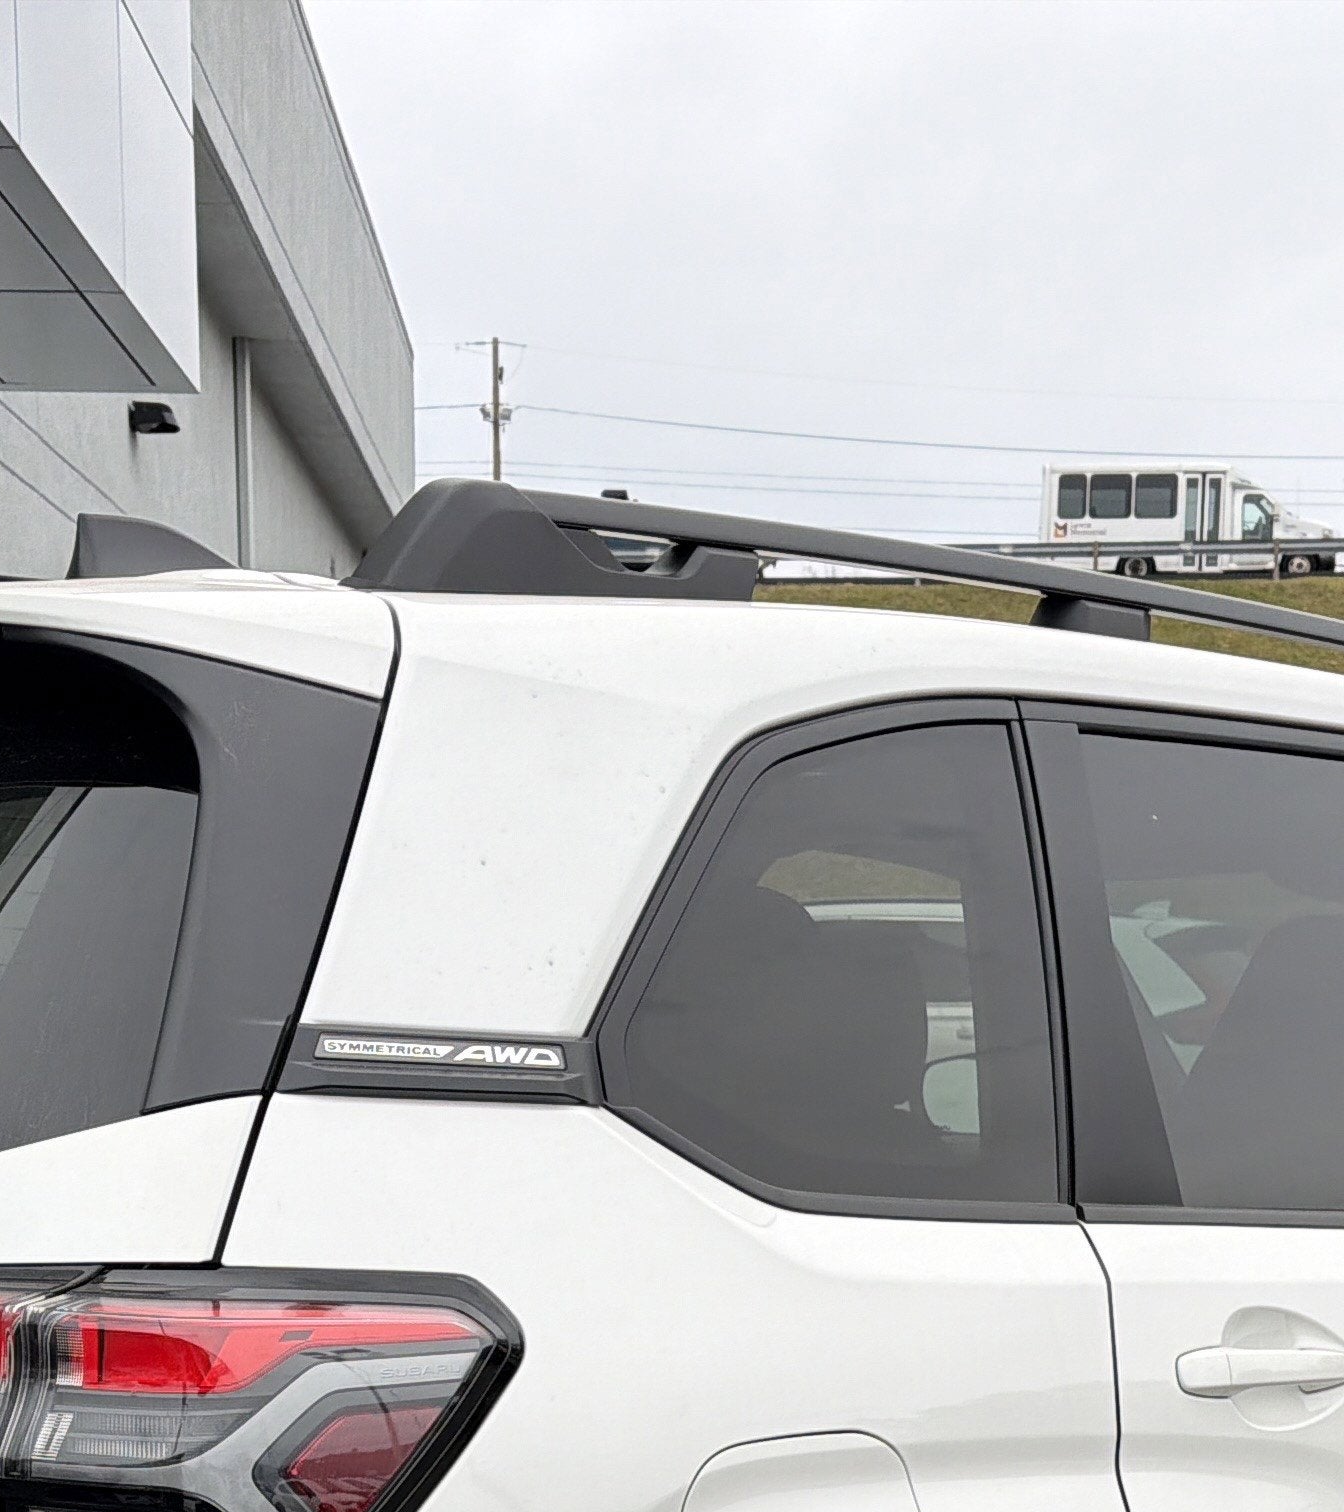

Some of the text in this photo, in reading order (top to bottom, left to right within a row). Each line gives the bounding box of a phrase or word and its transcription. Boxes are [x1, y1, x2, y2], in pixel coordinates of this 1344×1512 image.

[327, 1040, 561, 1067] SYMMETRICAL AWD
[380, 1365, 461, 1379] SUBARU
